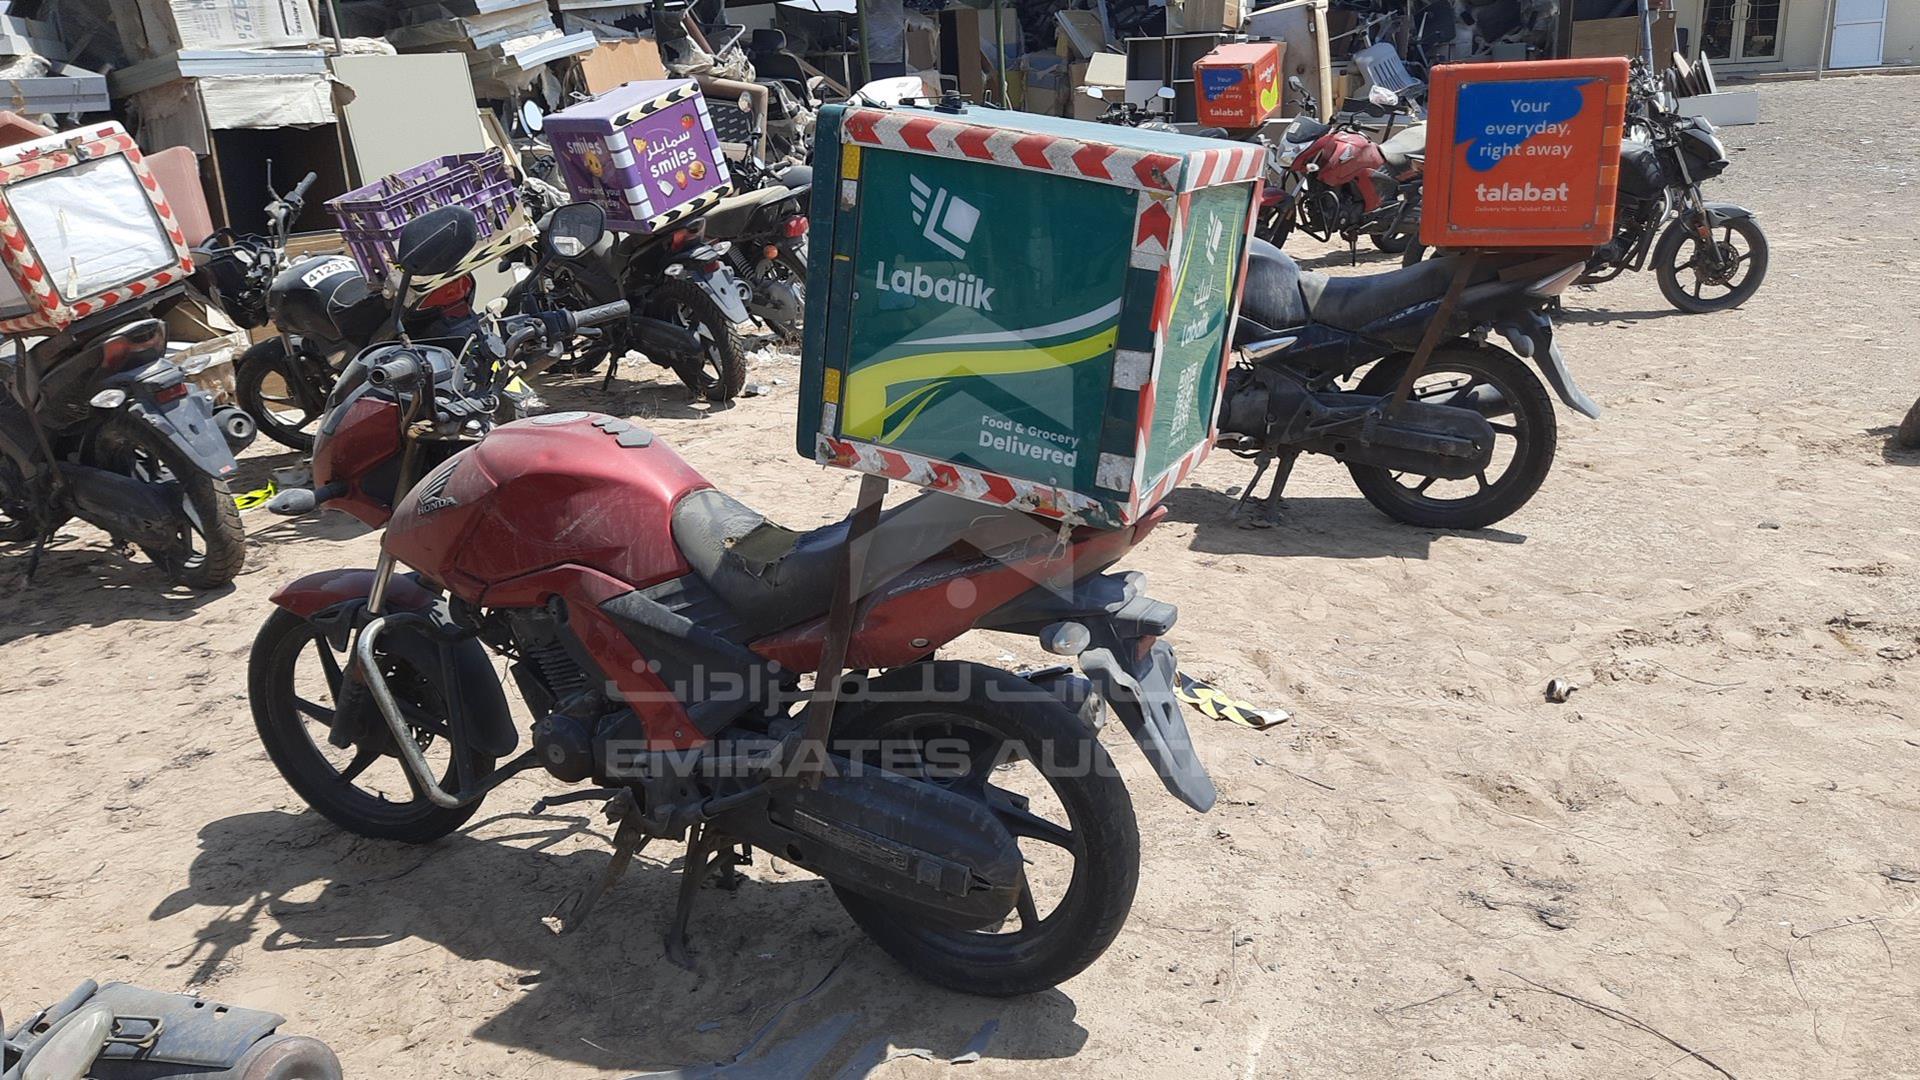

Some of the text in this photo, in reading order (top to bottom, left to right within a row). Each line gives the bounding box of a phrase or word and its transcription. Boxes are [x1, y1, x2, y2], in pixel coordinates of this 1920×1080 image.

[1210, 107, 1244, 117] talabat
[1510, 98, 1551, 113] Your
[1484, 120, 1571, 138] everyday,
[567, 136, 603, 155] smiles
[646, 131, 690, 161] سمايلز
[1479, 142, 1573, 161] right away
[650, 147, 697, 178] smiles
[1475, 182, 1569, 202] talabat
[876, 261, 996, 311] Labaiik
[981, 415, 1080, 449] Food & Grocery
[979, 430, 1078, 468] Delivered
[417, 496, 458, 516] HONDA
